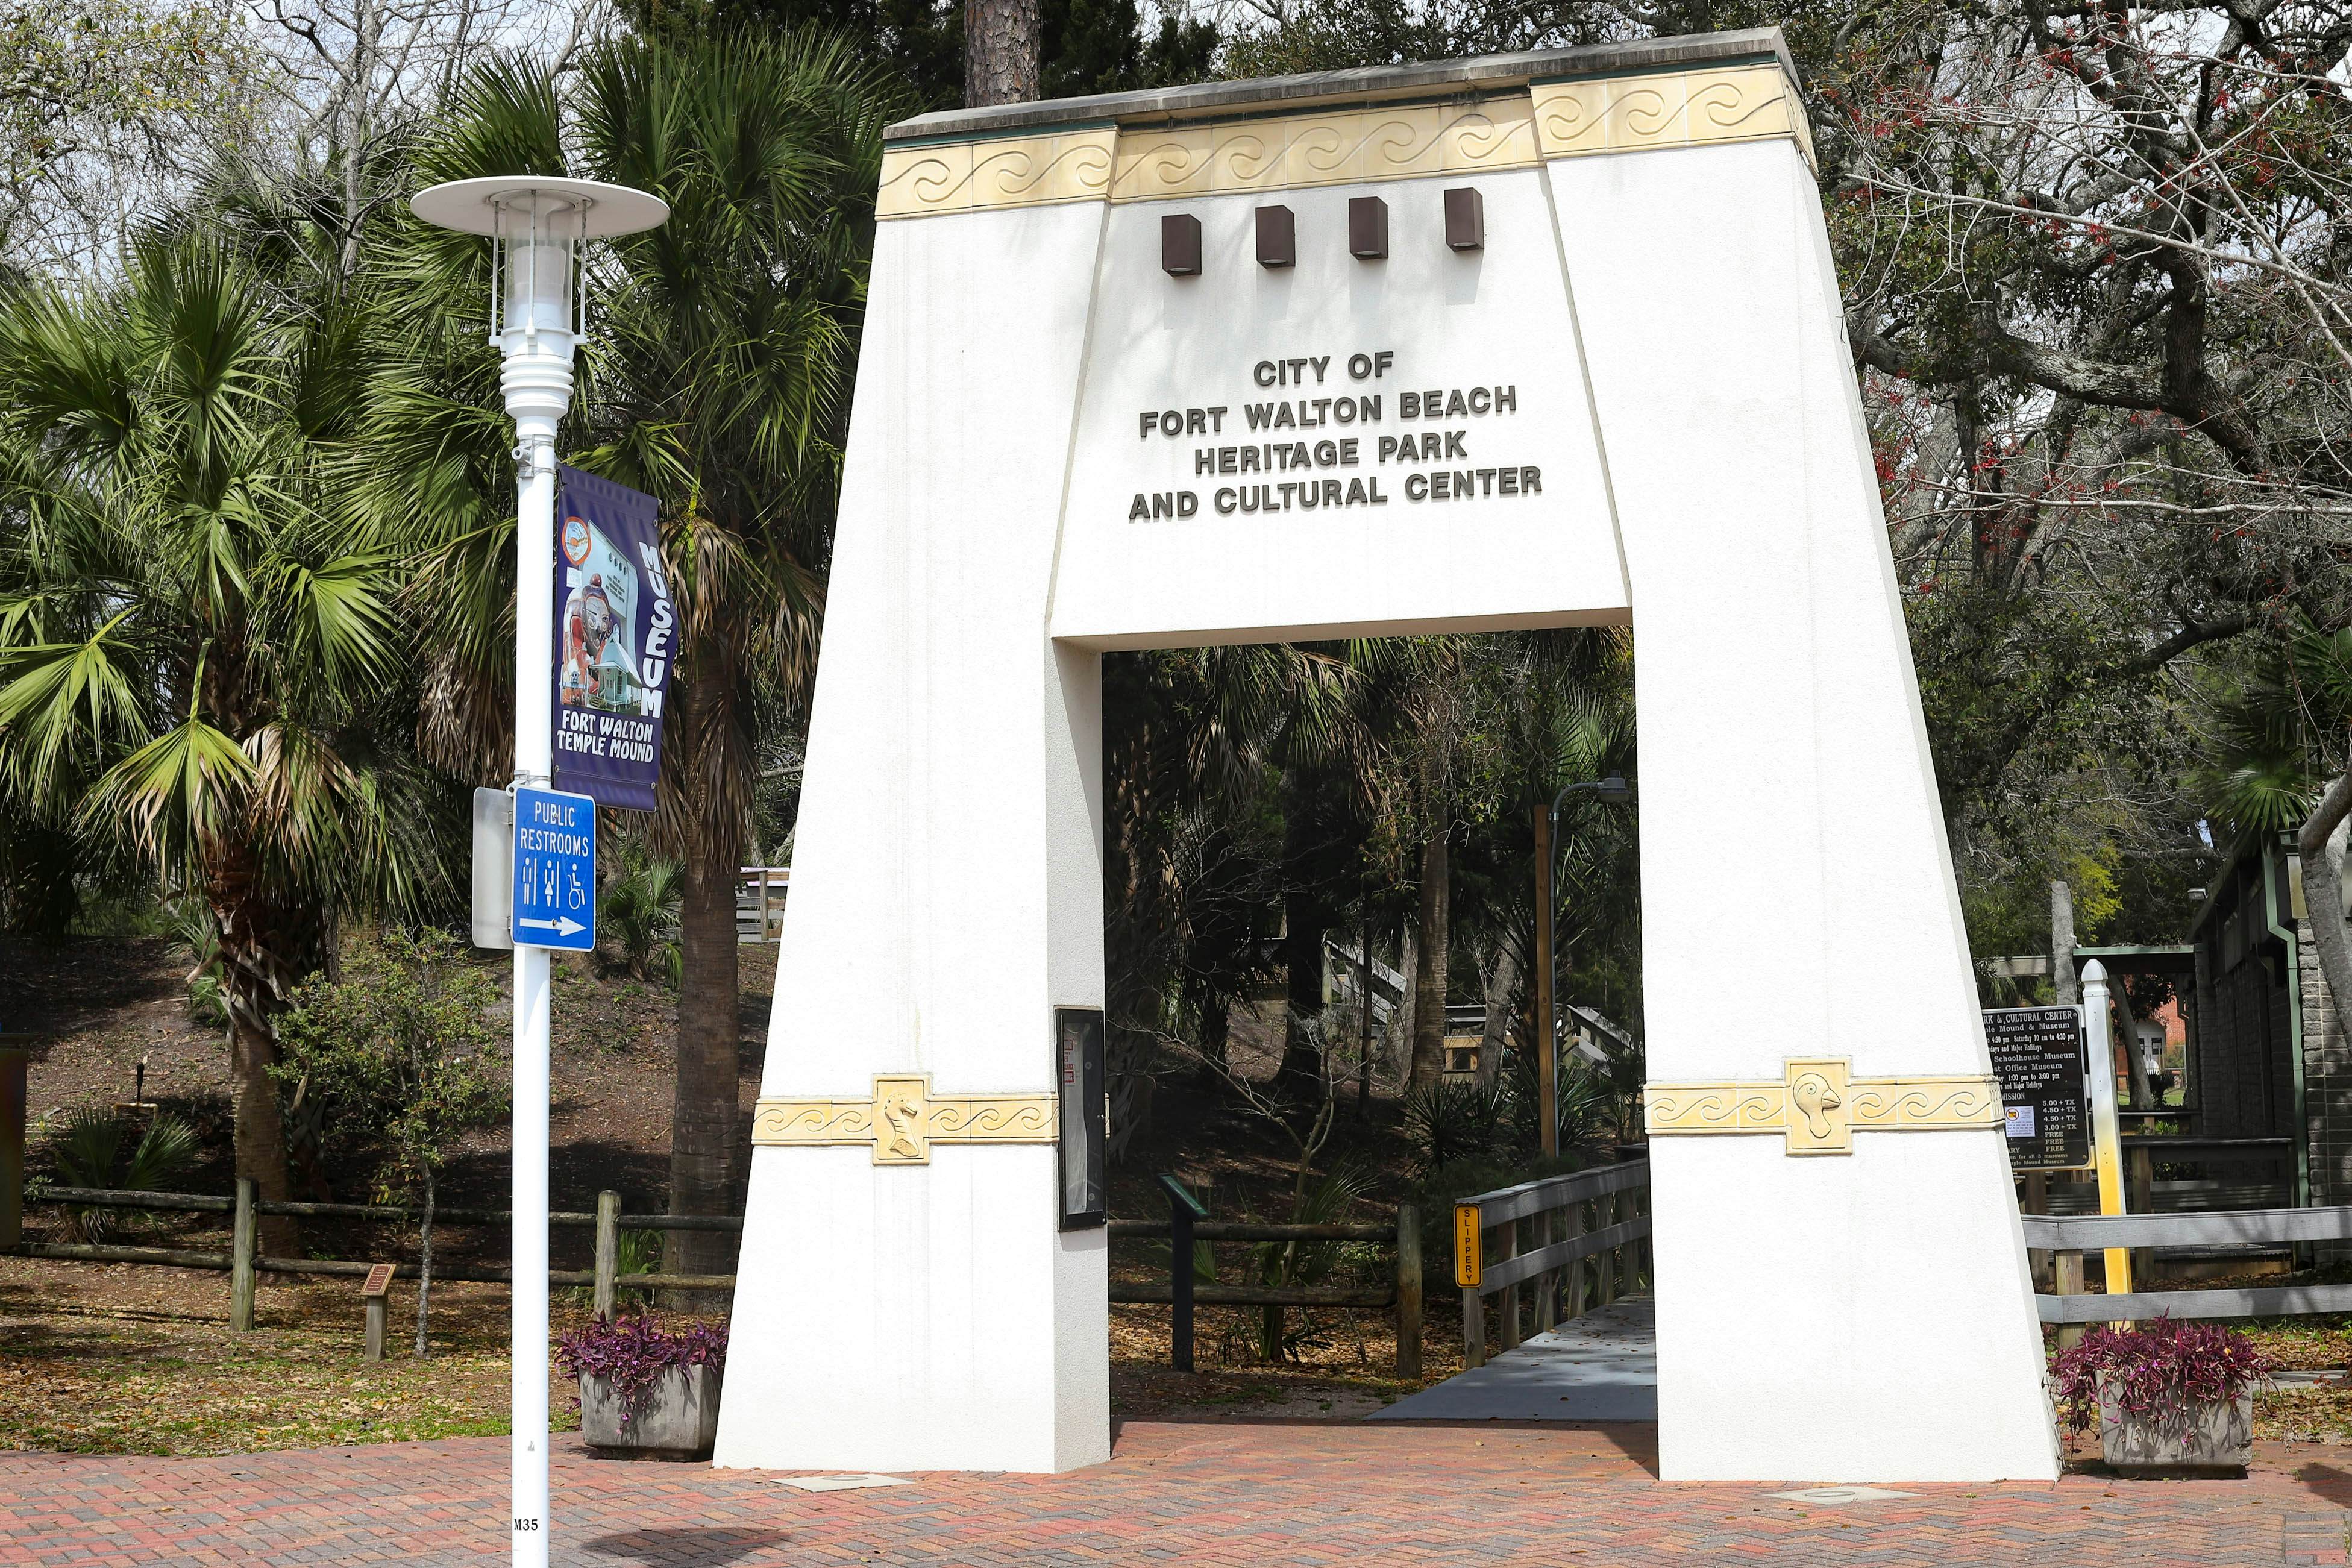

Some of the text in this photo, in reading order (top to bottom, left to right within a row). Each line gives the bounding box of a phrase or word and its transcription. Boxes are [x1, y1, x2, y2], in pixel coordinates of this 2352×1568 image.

[1254, 351, 1394, 386] CITY OF
[1140, 385, 1516, 437] FORT WALTON BEACH
[1195, 430, 1467, 474] HERITAGE PARK
[1129, 466, 1542, 519] AND CULTURAL CENTER
[639, 542, 673, 718] MUSEUM
[562, 709, 653, 742] FORT WALTON
[557, 730, 654, 763] TEMPLE MOUND
[535, 801, 575, 827] PUBLIC
[520, 827, 589, 858] RESTROOMS
[1983, 1011, 2072, 1024] RK & CULTURAL CENTER
[1999, 1024, 2025, 1032] Mound
[2011, 1044, 2022, 1053] Major
[2024, 1043, 2042, 1052] Holidays
[2014, 1035, 2032, 1044] Saturday
[2005, 1064, 2028, 1072] Office
[2013, 1082, 2024, 1091] Major
[2026, 1080, 2042, 1090] Holidays
[1464, 1209, 1472, 1282] SLIPPERY
[514, 1518, 538, 1531] M35
